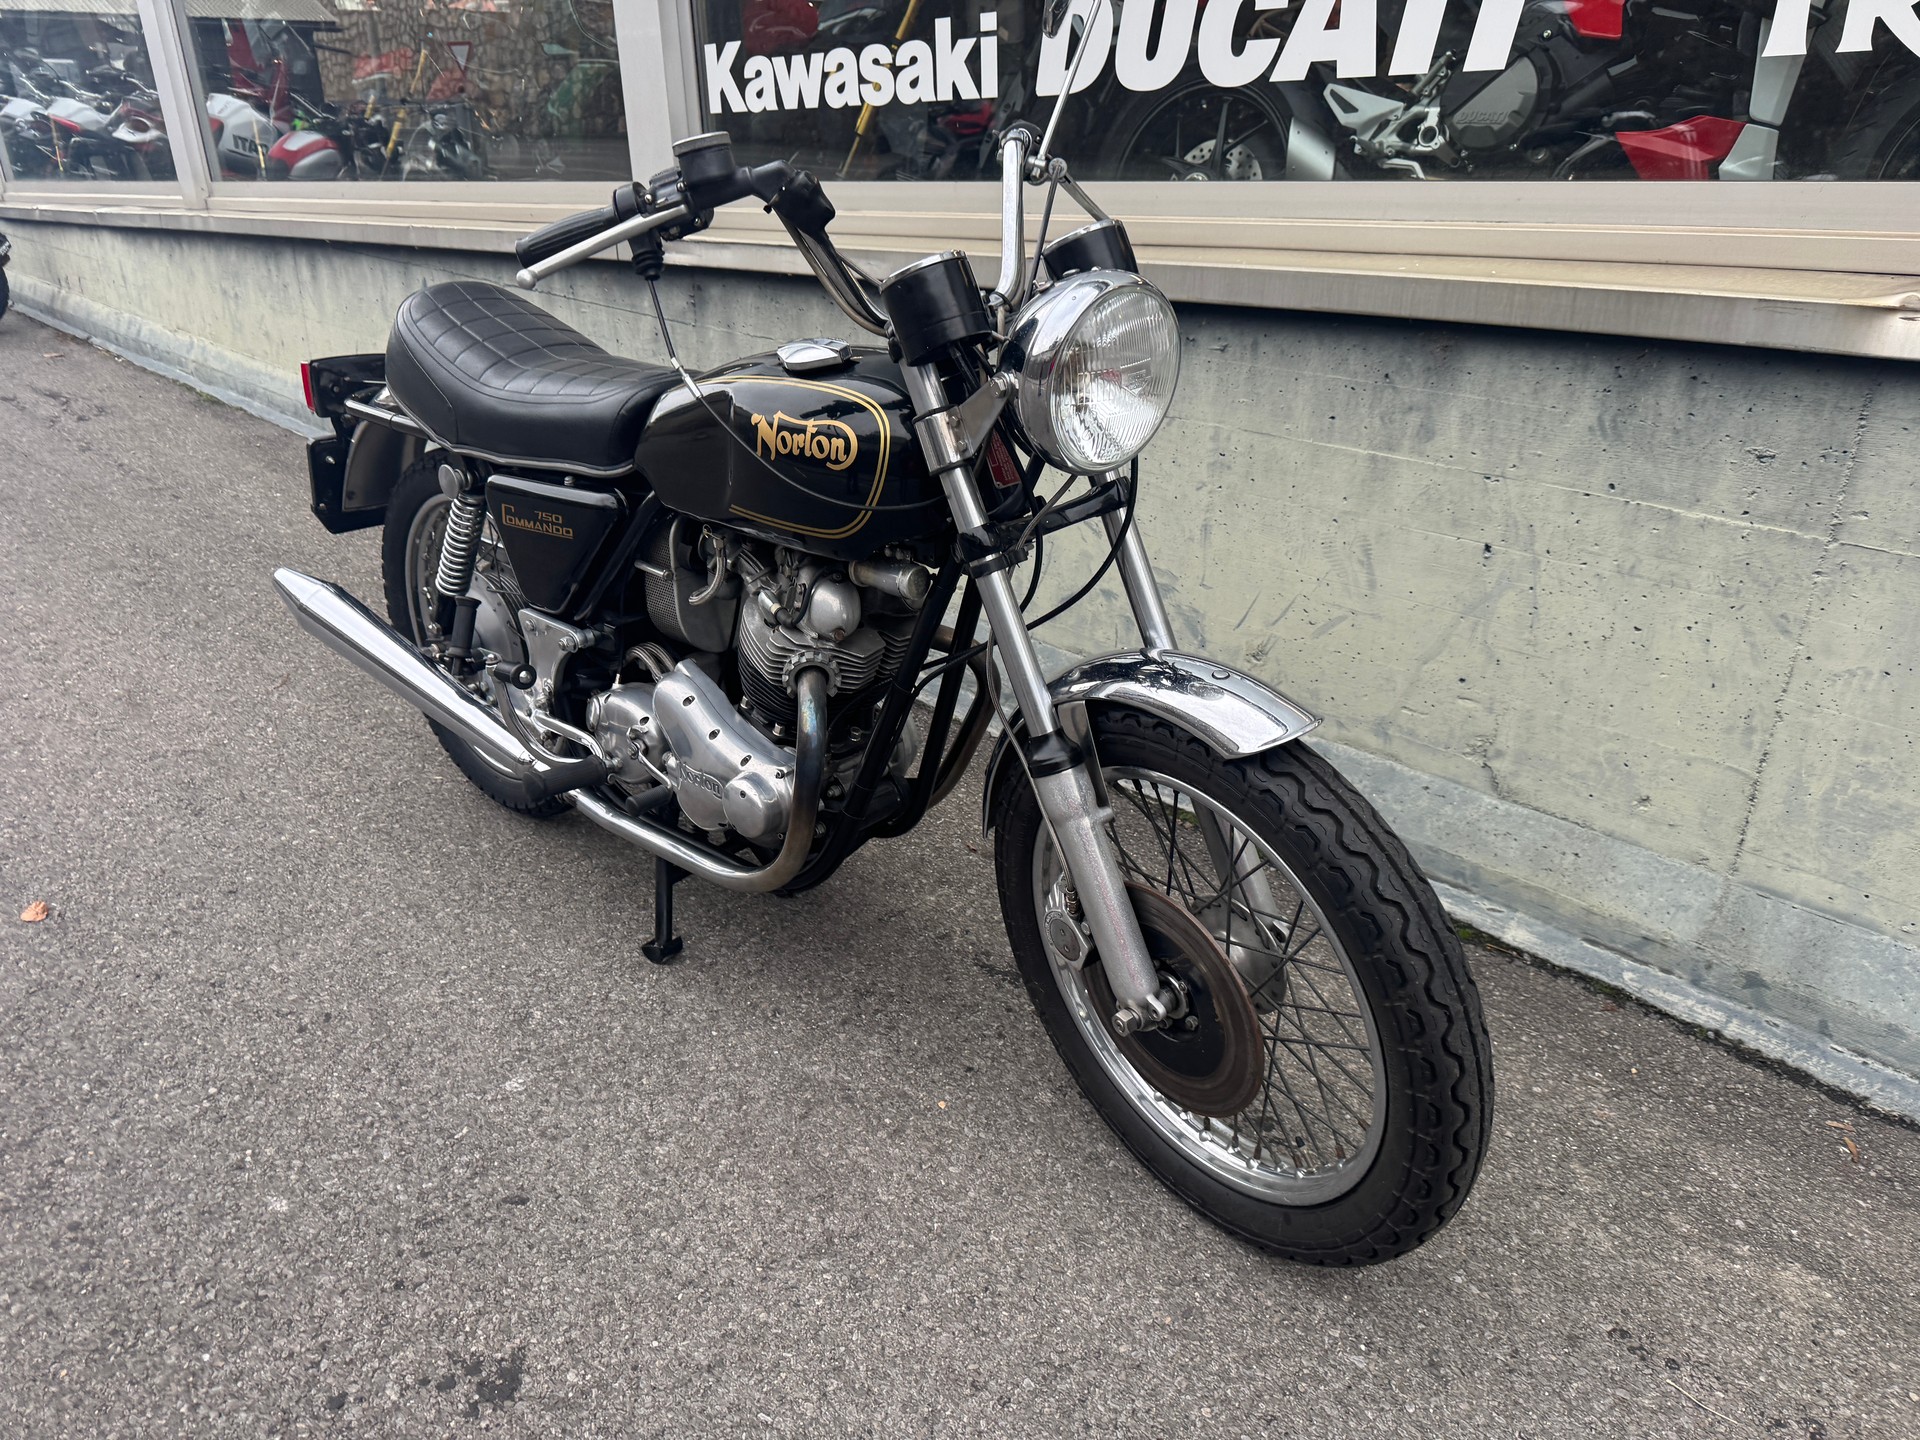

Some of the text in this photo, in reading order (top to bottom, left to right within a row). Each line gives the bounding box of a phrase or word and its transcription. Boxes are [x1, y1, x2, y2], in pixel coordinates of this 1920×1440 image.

[704, 12, 998, 114] Kawasaki
[1036, 0, 1525, 97] DUCATI
[751, 410, 858, 471] Norton
[501, 503, 574, 539] COMMANDO
[534, 511, 563, 524] 750
